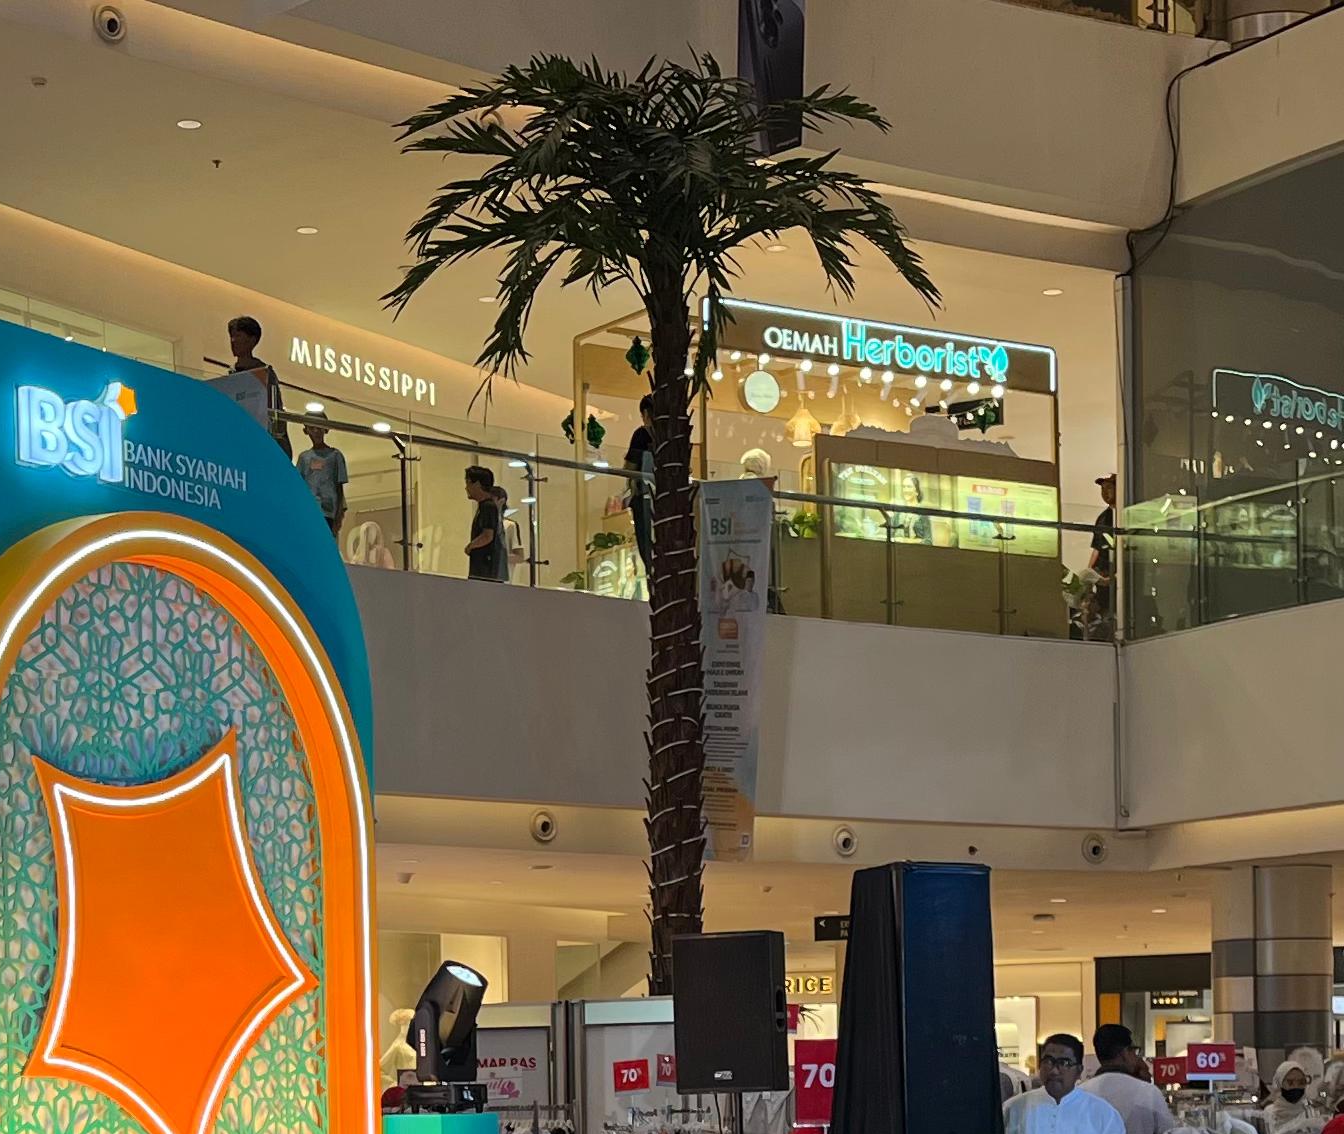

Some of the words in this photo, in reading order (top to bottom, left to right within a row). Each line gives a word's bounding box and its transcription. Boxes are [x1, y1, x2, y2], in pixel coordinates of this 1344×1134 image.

[289, 336, 436, 406] MISSISSIPPI
[763, 326, 838, 357] OEMAH
[841, 318, 981, 378] Herborist
[16, 385, 124, 483] BSI
[124, 439, 173, 473] BANK
[175, 453, 247, 491] SYARIAH
[124, 466, 222, 510] INDONESIA
[711, 517, 732, 535] BSI
[477, 1057, 506, 1069] MAR
[509, 1057, 537, 1069] PAS
[801, 1063, 836, 1089] 70
